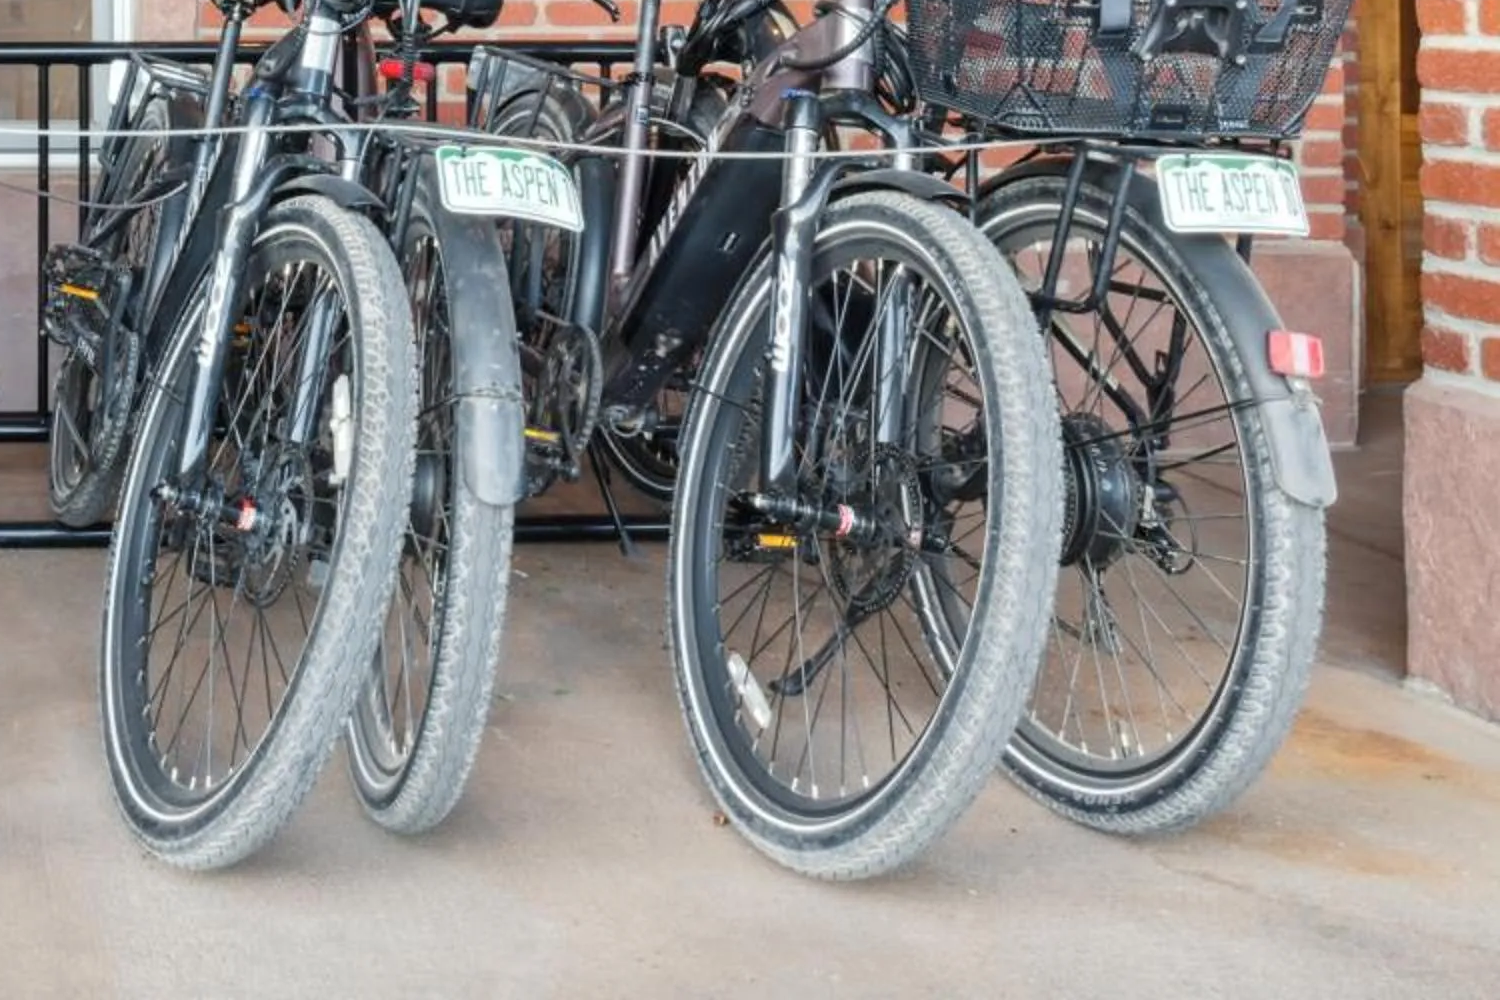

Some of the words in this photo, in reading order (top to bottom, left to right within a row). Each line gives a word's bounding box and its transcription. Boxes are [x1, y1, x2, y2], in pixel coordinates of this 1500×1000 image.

[449, 159, 493, 198] THE
[500, 162, 560, 207] ASPEN
[1171, 170, 1215, 213] THE
[1221, 172, 1280, 216] ASPEN
